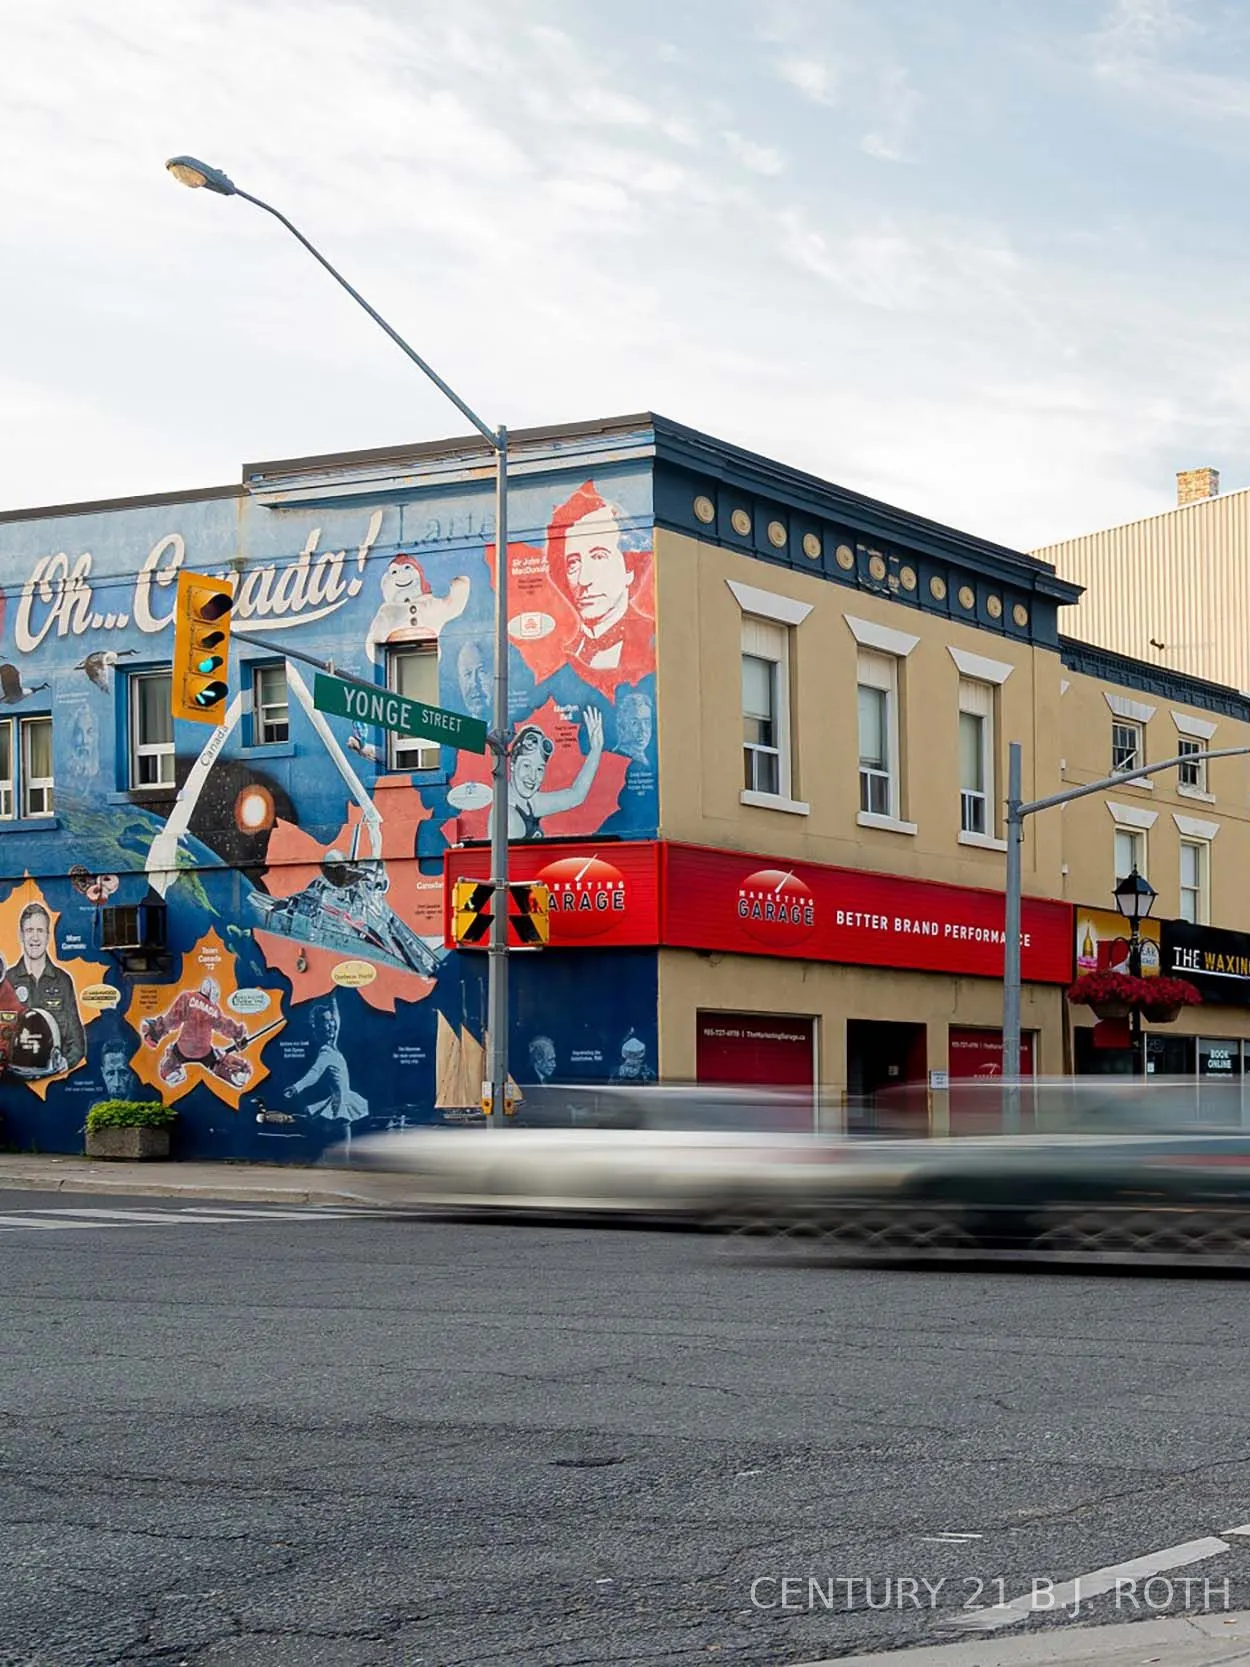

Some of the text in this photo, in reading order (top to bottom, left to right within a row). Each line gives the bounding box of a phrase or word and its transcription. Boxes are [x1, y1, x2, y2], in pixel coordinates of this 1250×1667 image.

[133, 509, 382, 633] Cada!
[343, 686, 462, 733] YONGE STREET
[545, 881, 625, 891] RKETING
[548, 891, 625, 912] ARAGE
[738, 889, 814, 906] MARKETING
[737, 899, 814, 926] GARAGE
[836, 910, 1031, 947] BETTER BRAND PERFORMACE
[1173, 946, 1200, 970] THE
[1207, 1059, 1232, 1069] ONLINE
[1210, 1049, 1230, 1059] BOOK
